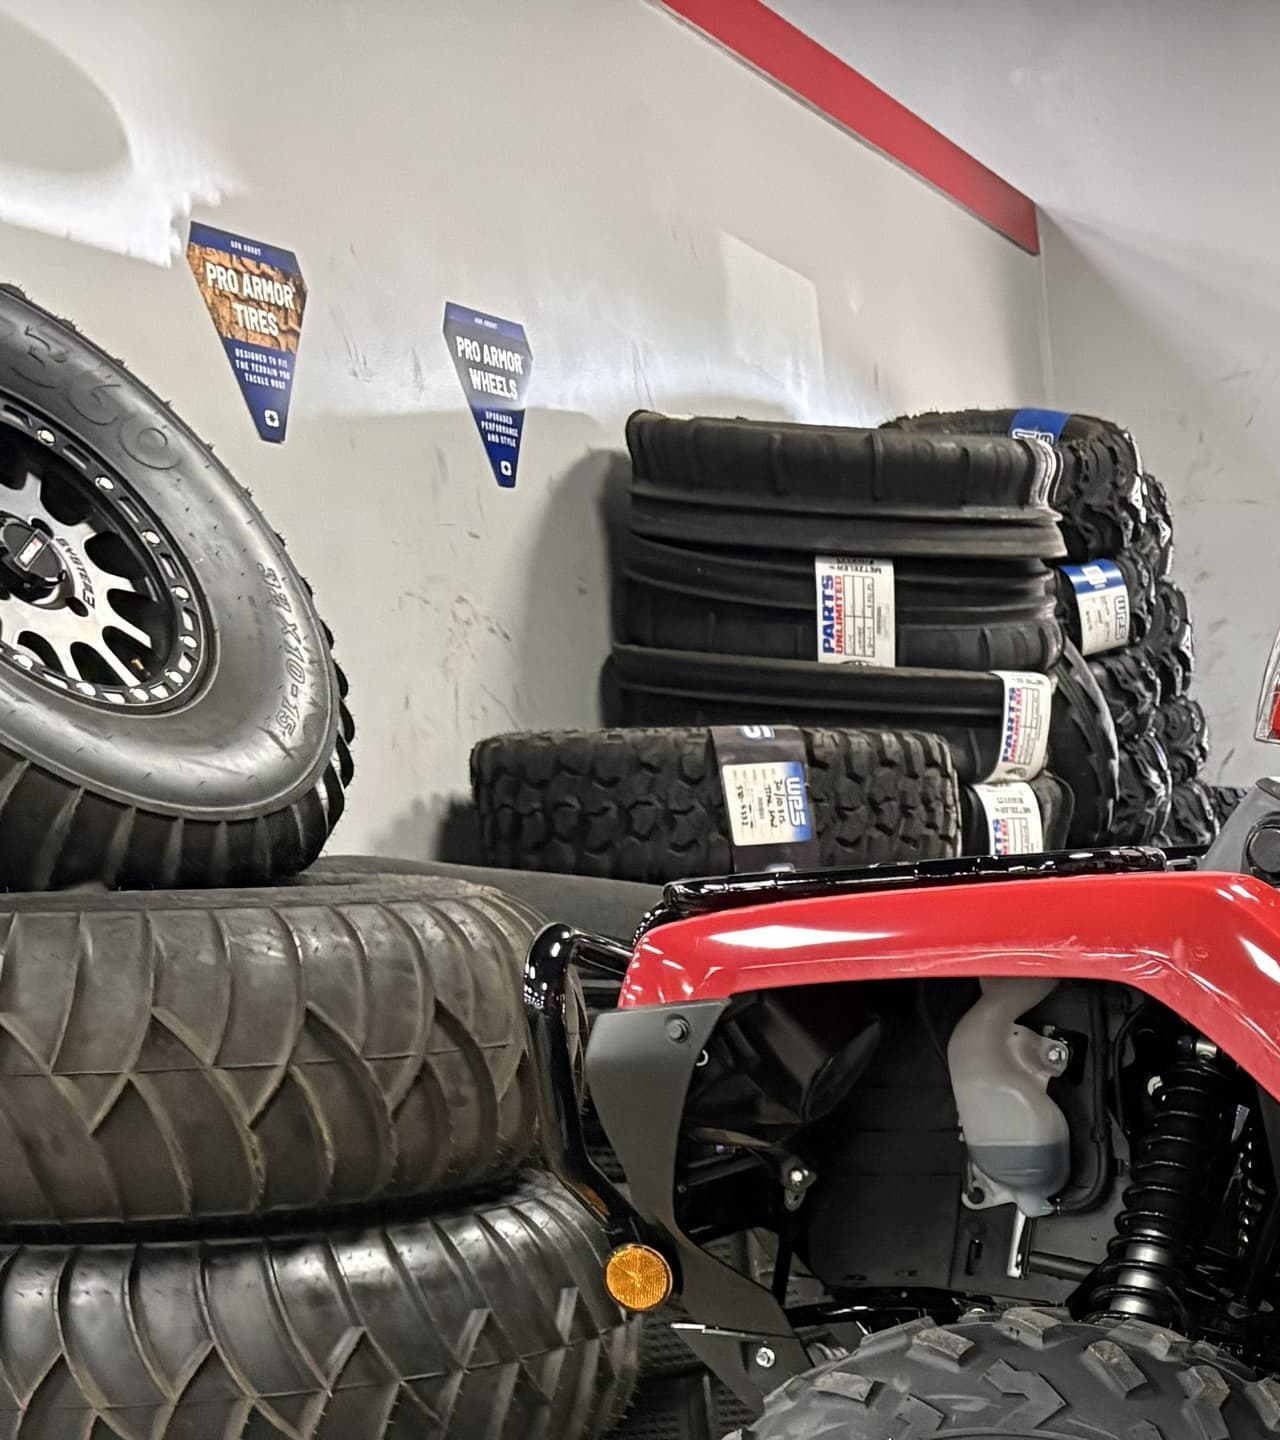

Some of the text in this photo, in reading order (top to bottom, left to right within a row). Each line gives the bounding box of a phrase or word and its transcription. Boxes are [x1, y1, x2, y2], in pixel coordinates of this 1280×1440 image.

[205, 262, 295, 310] PRO ARMOR
[232, 303, 279, 336] TIRES
[456, 335, 523, 375] PRO ARMOR
[469, 367, 518, 400] WHEELS
[822, 574, 835, 653] PARTS
[835, 575, 843, 655] UNLIMITED
[1114, 595, 1127, 641] WPS
[1001, 687, 1016, 763] PARTS
[785, 777, 807, 827] WPS
